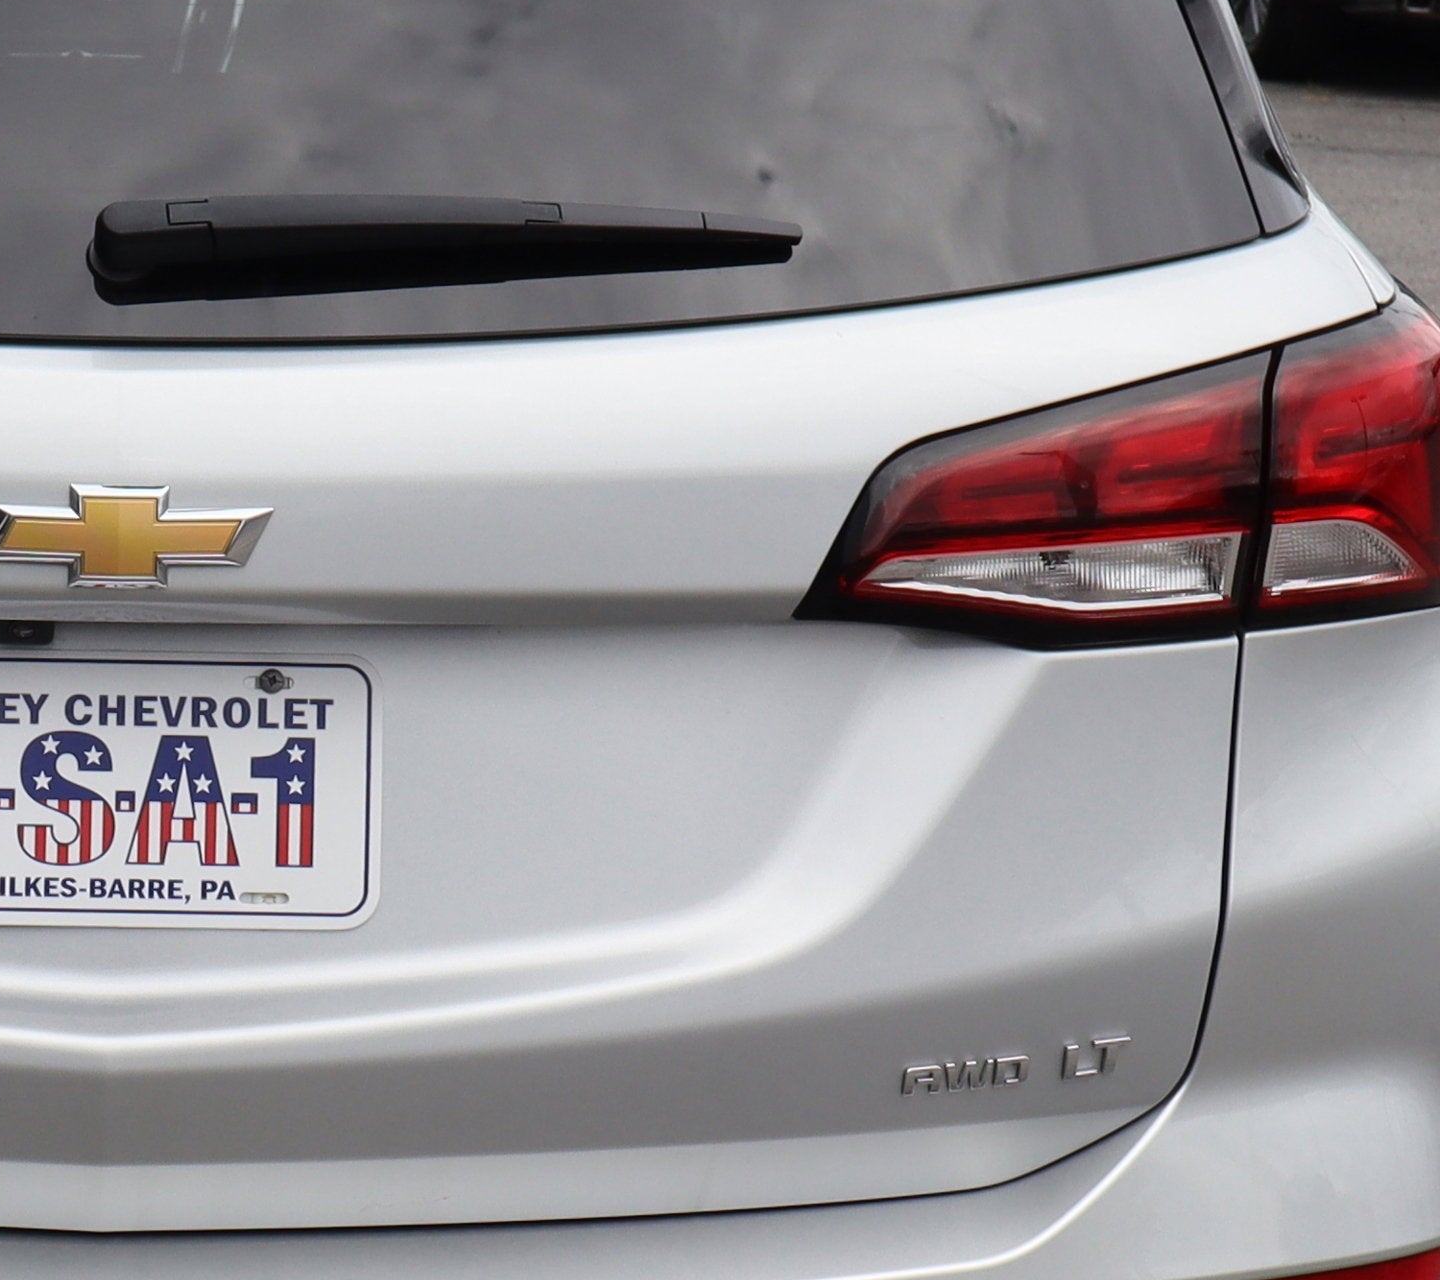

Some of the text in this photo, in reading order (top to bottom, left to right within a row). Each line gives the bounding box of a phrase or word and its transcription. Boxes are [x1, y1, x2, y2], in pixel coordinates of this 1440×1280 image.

[64, 694, 335, 731] CHEVROLET
[201, 880, 237, 902] PA
[901, 1036, 1131, 1096] AWD LT
